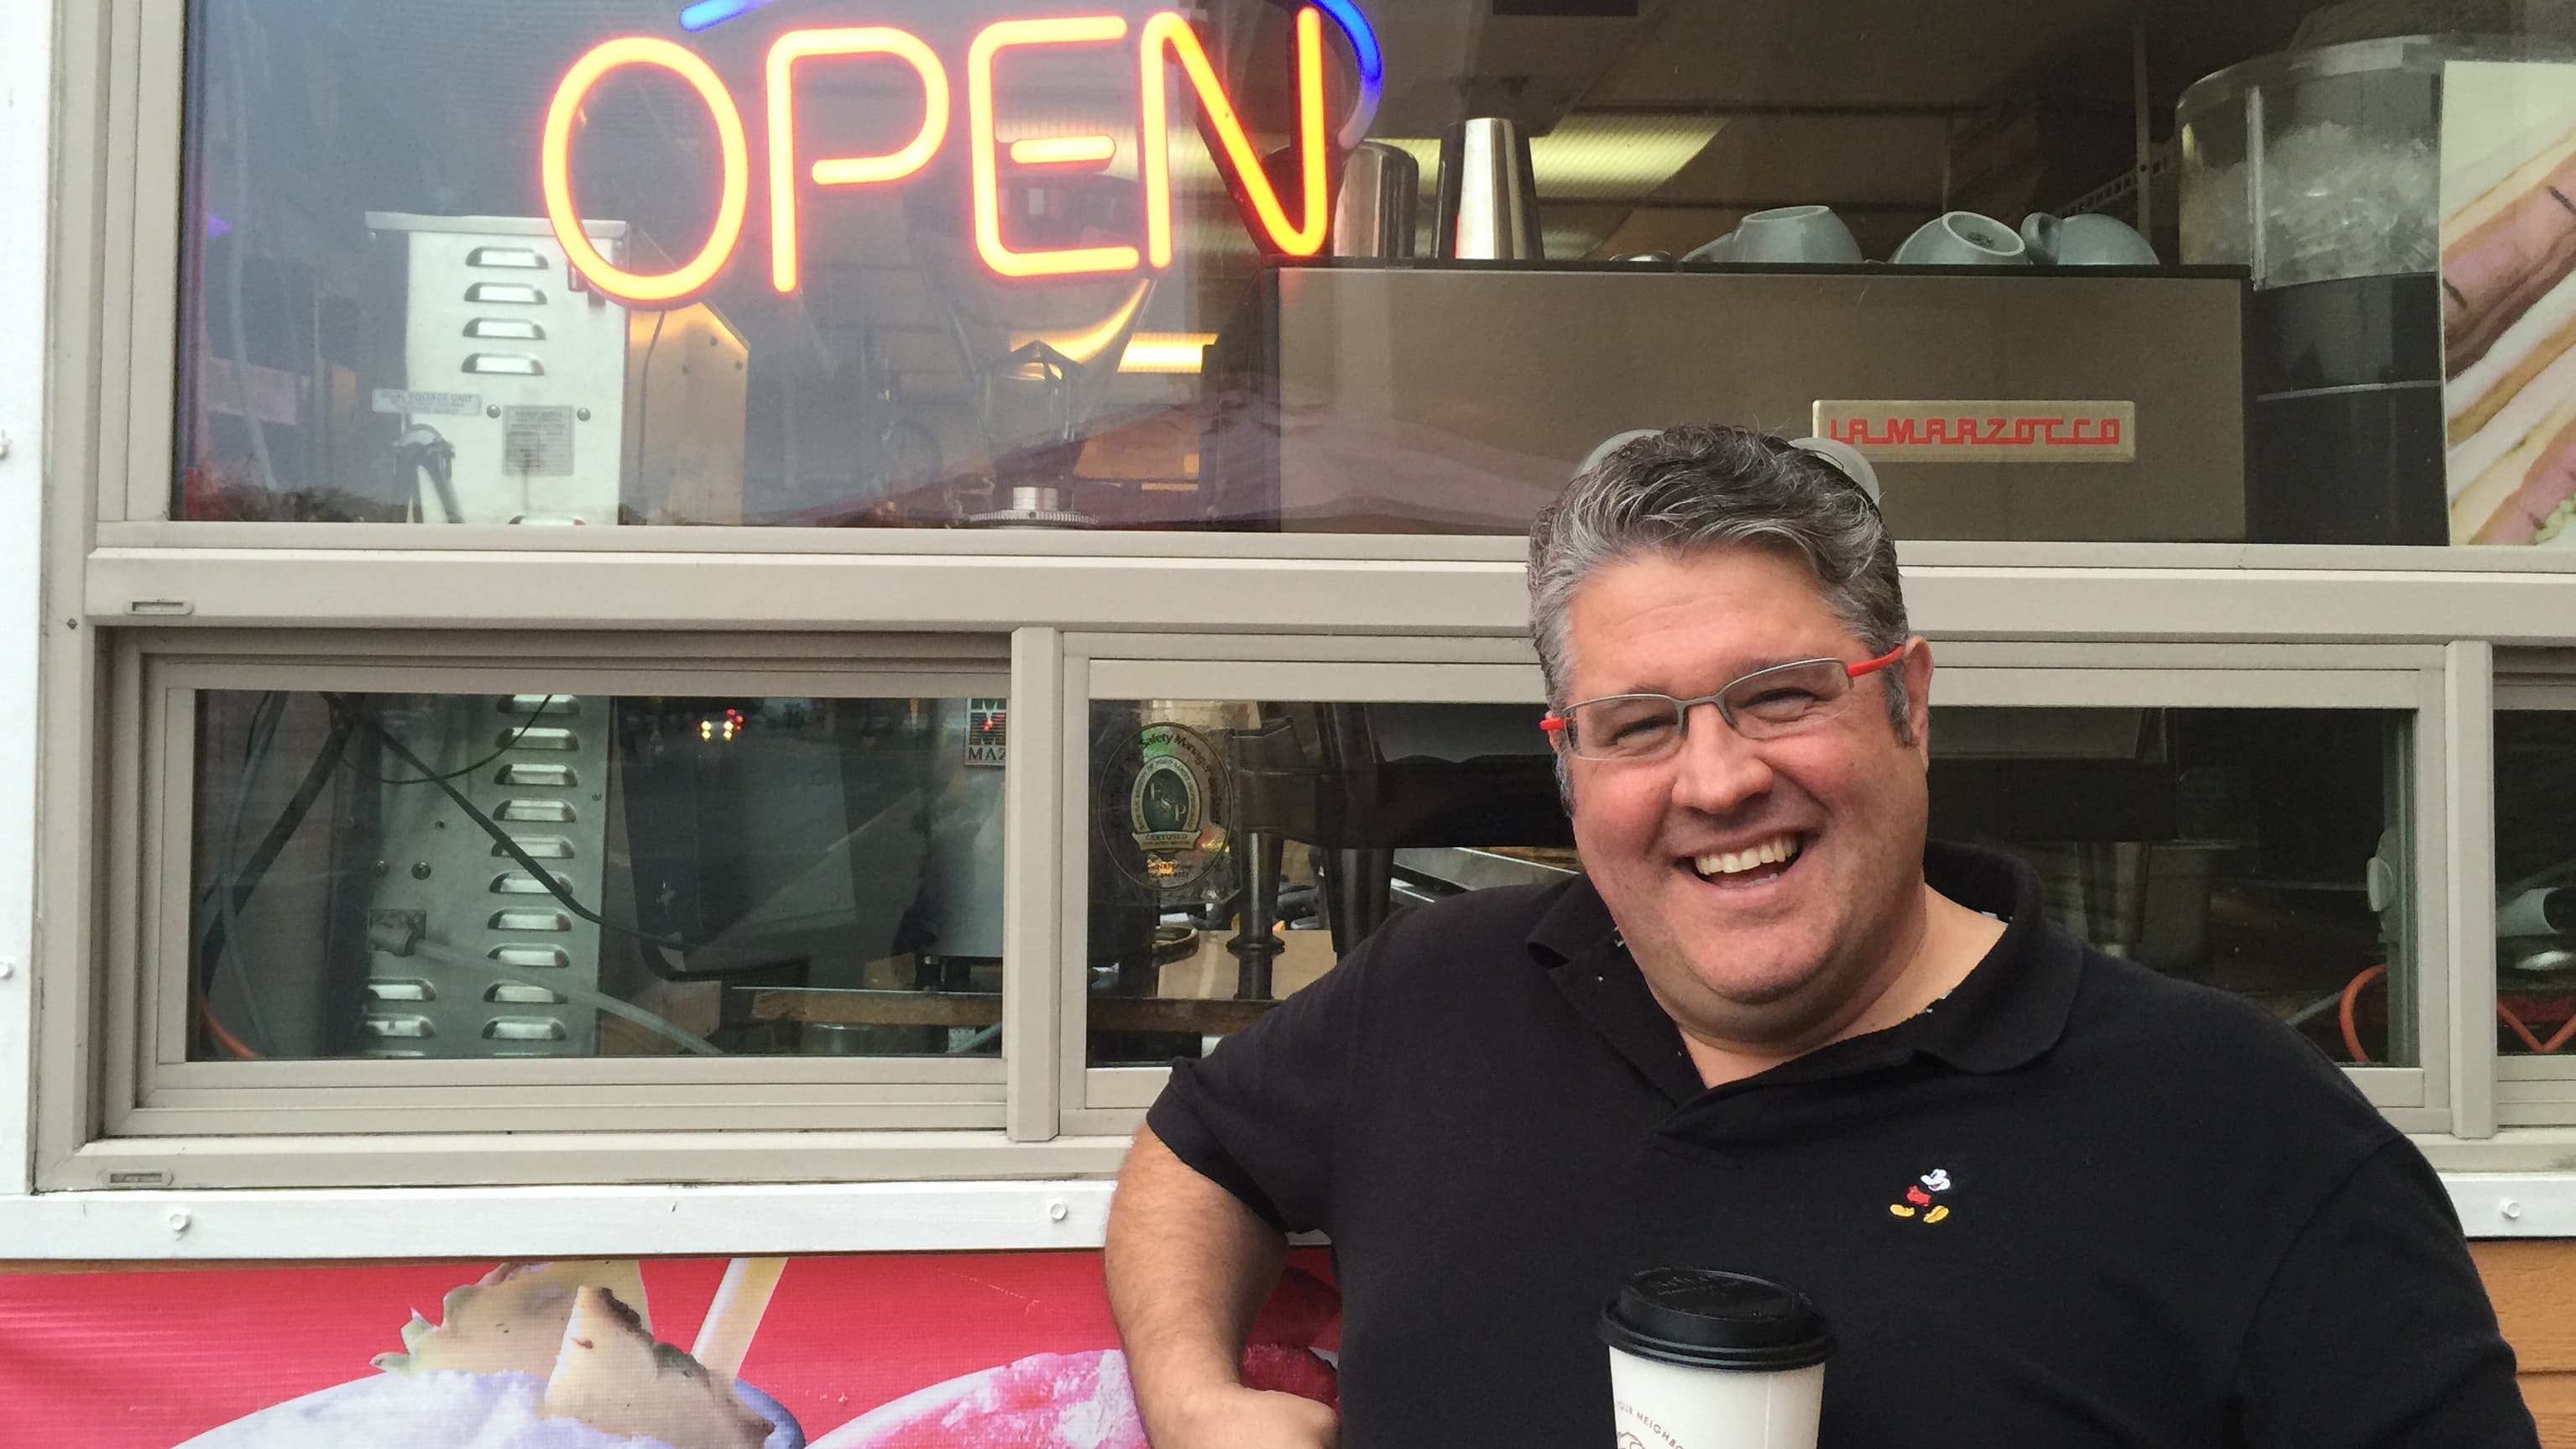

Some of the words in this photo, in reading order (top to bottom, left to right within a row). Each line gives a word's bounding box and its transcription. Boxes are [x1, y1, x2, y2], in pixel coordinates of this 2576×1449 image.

[541, 6, 1328, 303] OPEN
[1139, 733, 1173, 748] Safety
[1174, 734, 1210, 772] Manager
